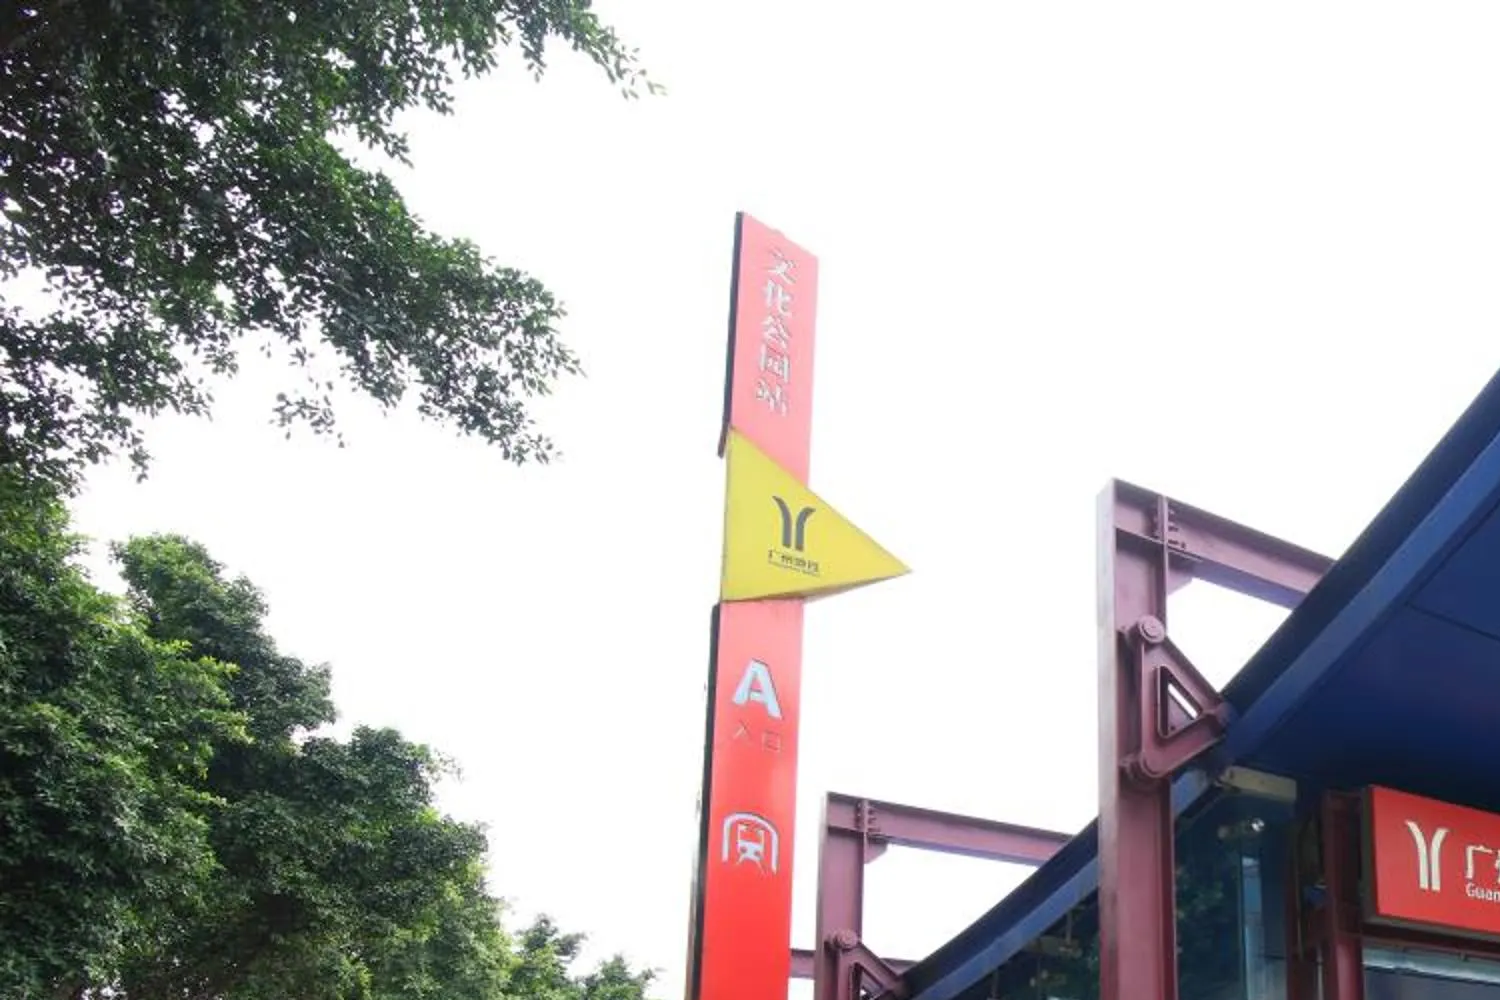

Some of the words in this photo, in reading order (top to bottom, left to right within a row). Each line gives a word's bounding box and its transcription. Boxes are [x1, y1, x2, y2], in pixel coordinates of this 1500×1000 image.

[755, 247, 797, 417] 文化公园站
[731, 657, 783, 721] A
